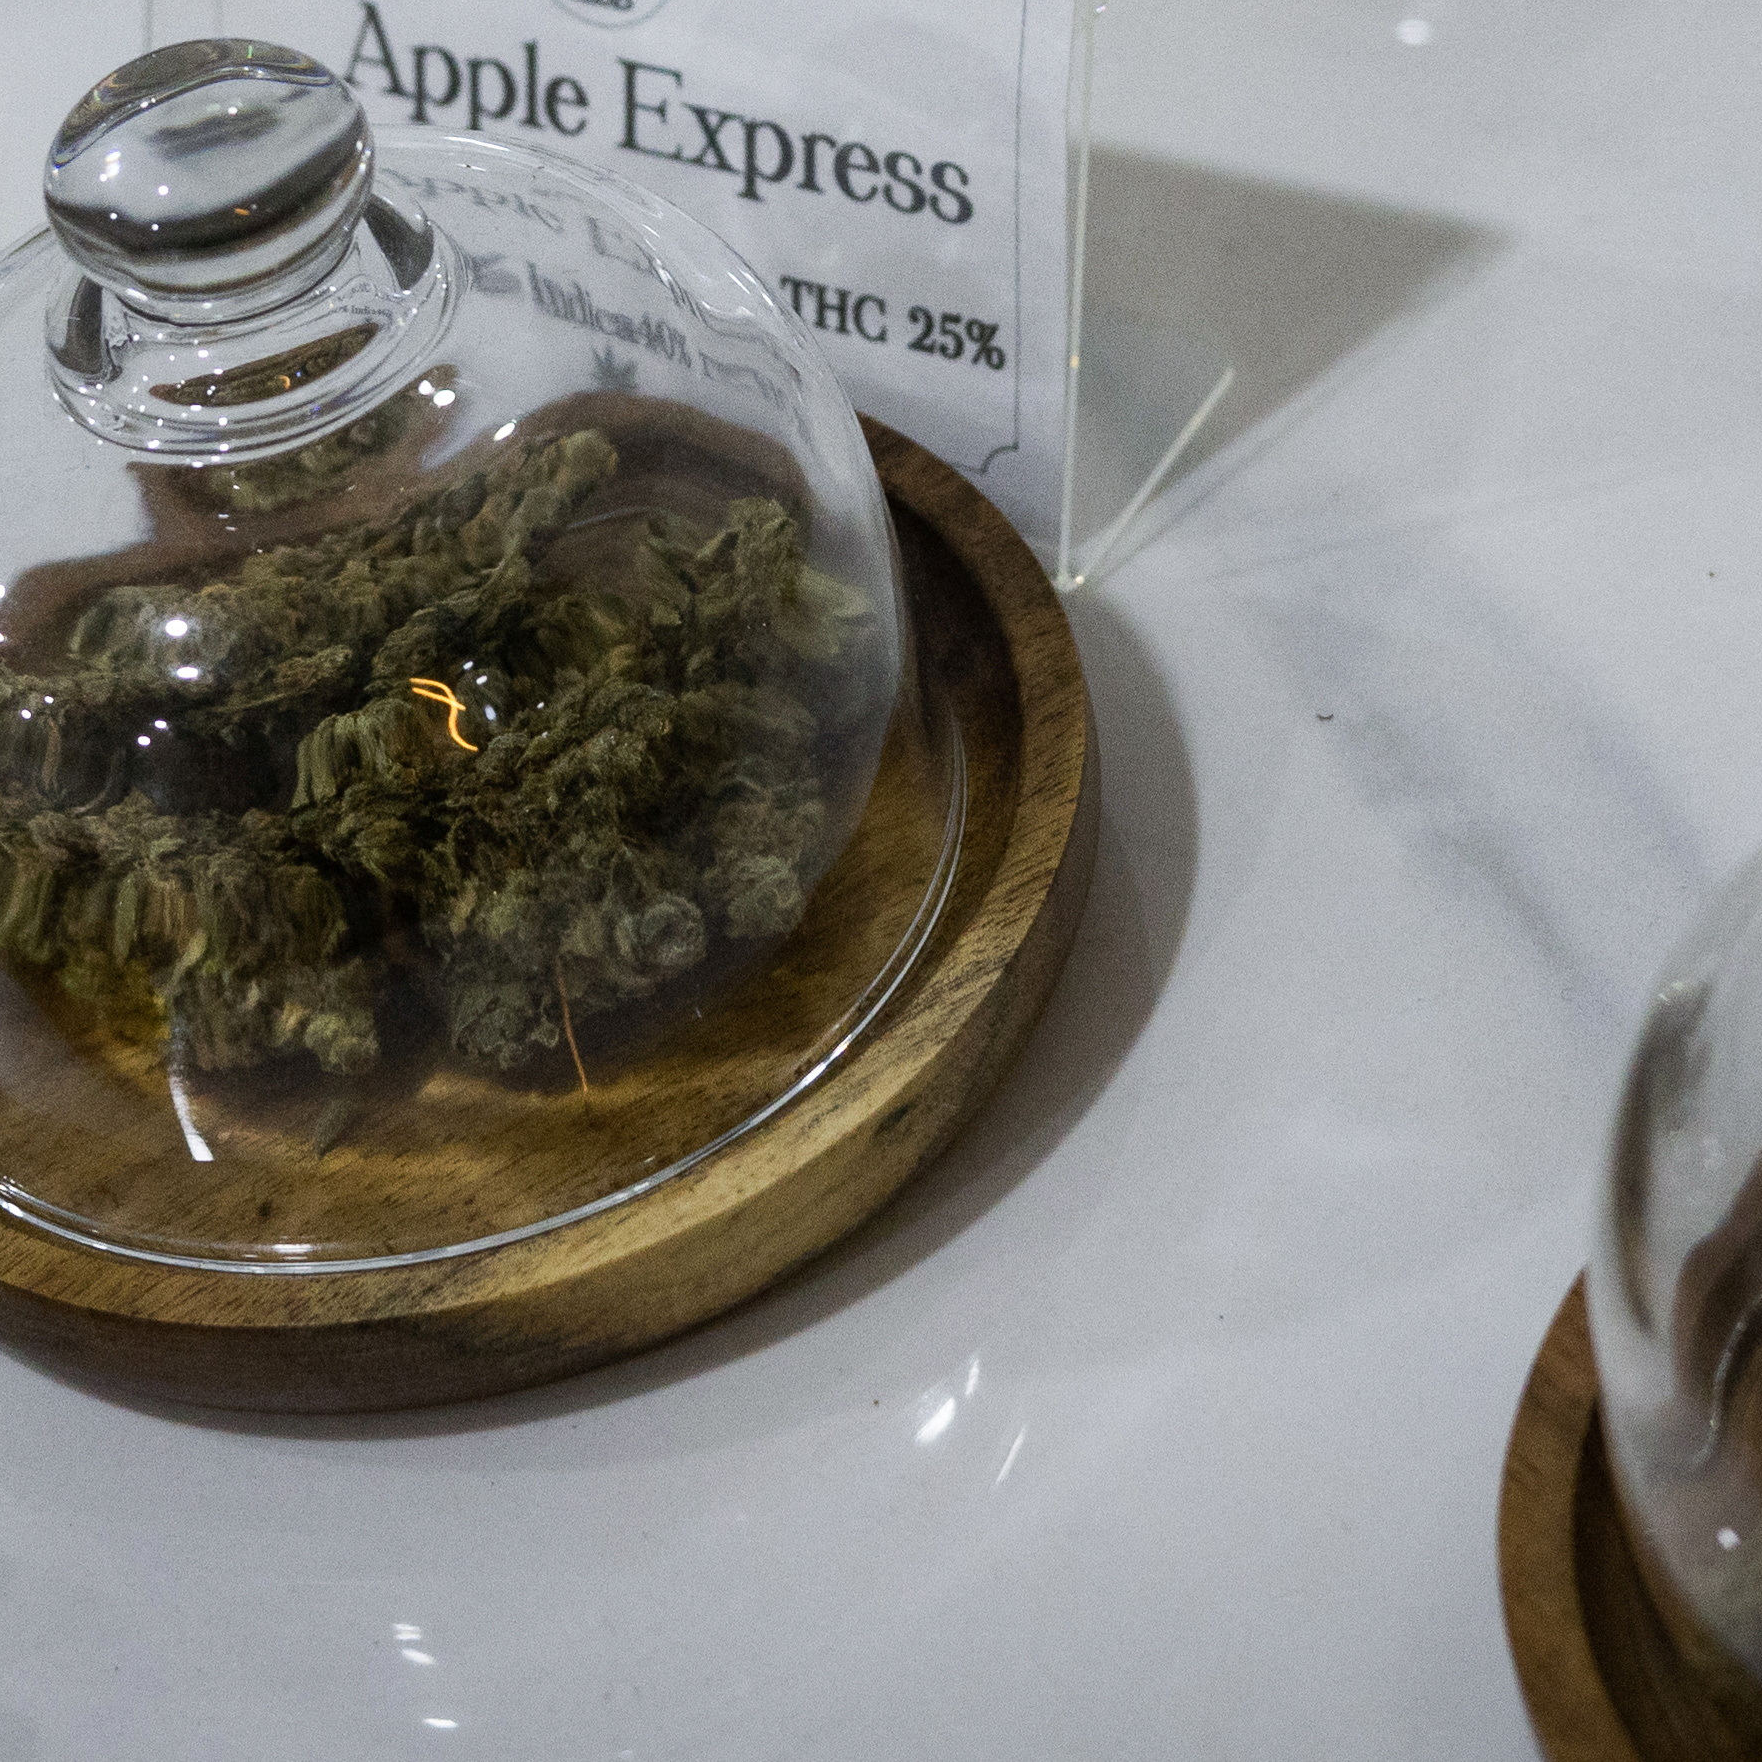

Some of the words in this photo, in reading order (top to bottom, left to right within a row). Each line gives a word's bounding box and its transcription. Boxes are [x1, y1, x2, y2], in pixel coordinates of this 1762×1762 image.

[616, 56, 974, 225] Express
[779, 274, 889, 344] THC
[906, 305, 1007, 371] 25%
